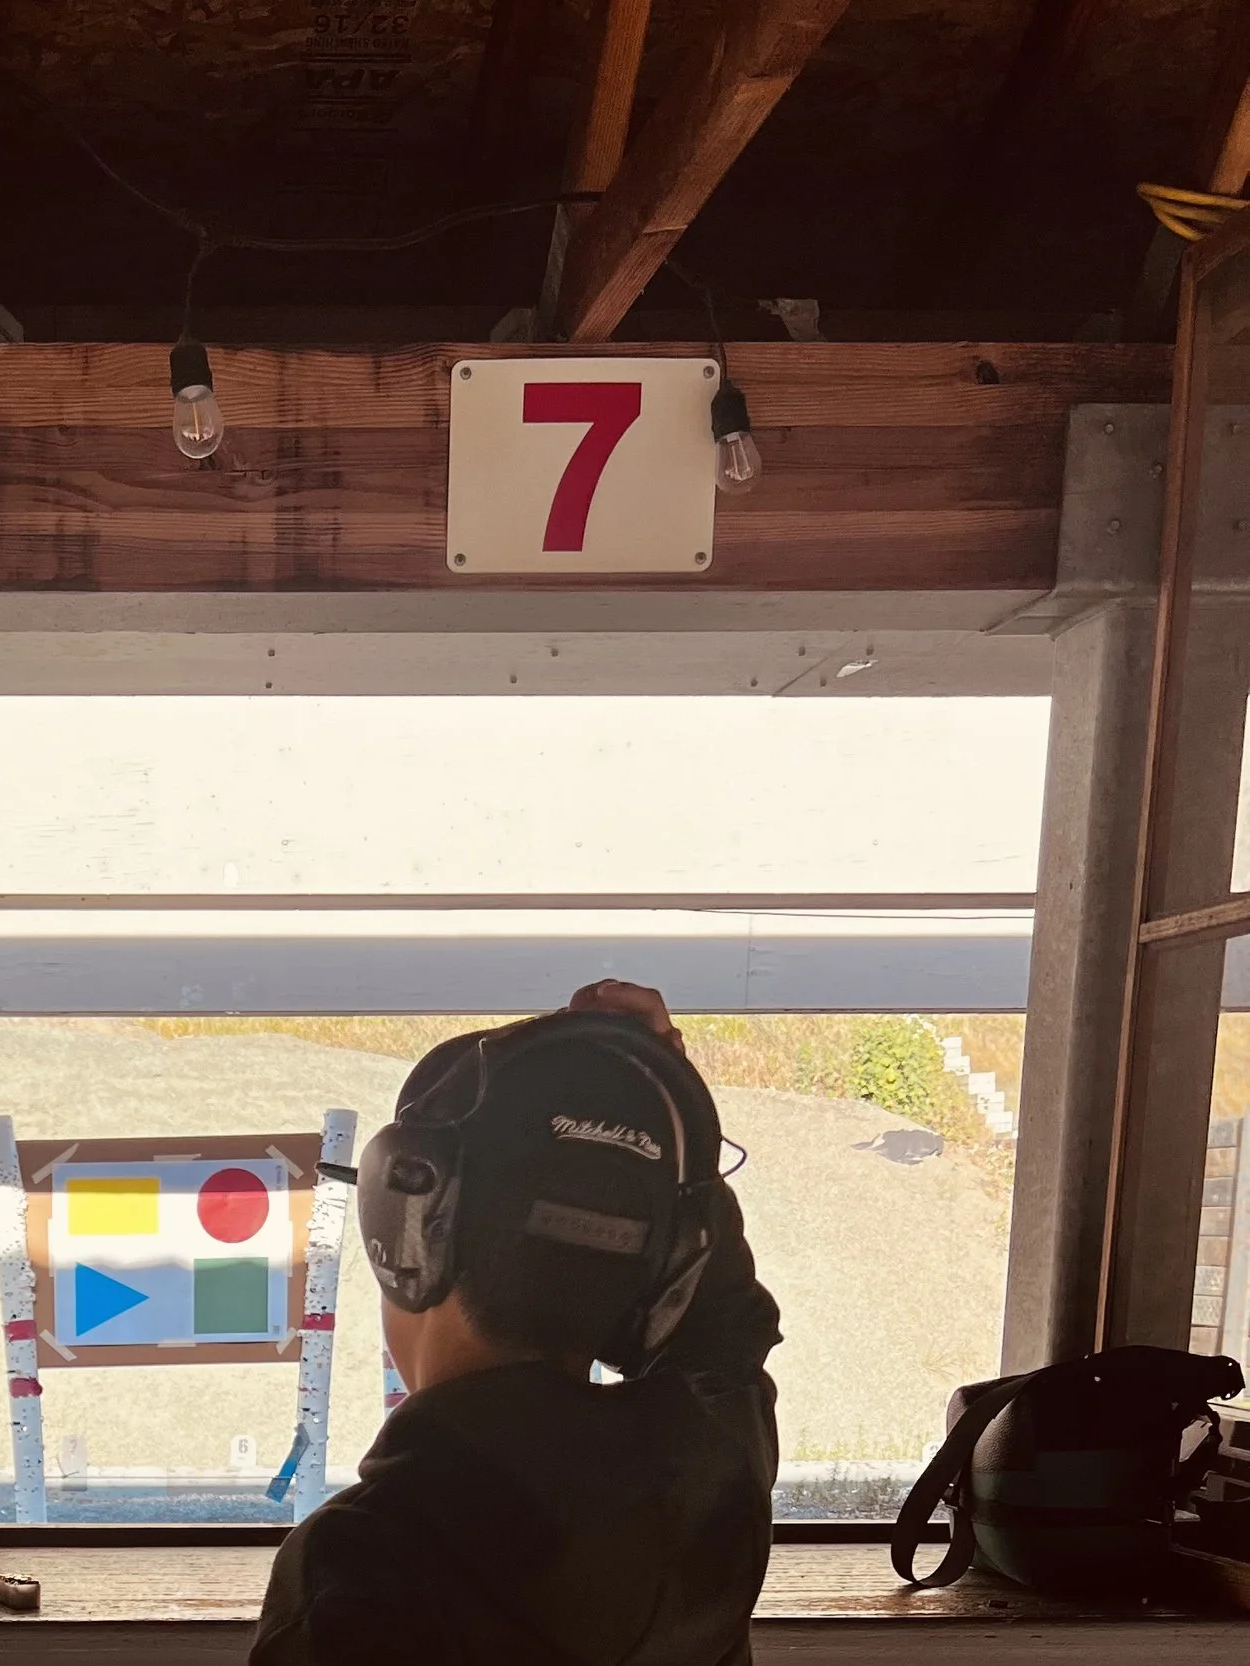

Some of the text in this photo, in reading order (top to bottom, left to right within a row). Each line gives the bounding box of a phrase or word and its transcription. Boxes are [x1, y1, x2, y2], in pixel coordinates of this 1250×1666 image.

[313, 11, 410, 34] 32/16
[522, 382, 642, 553] 7
[238, 1438, 249, 1454] 6
